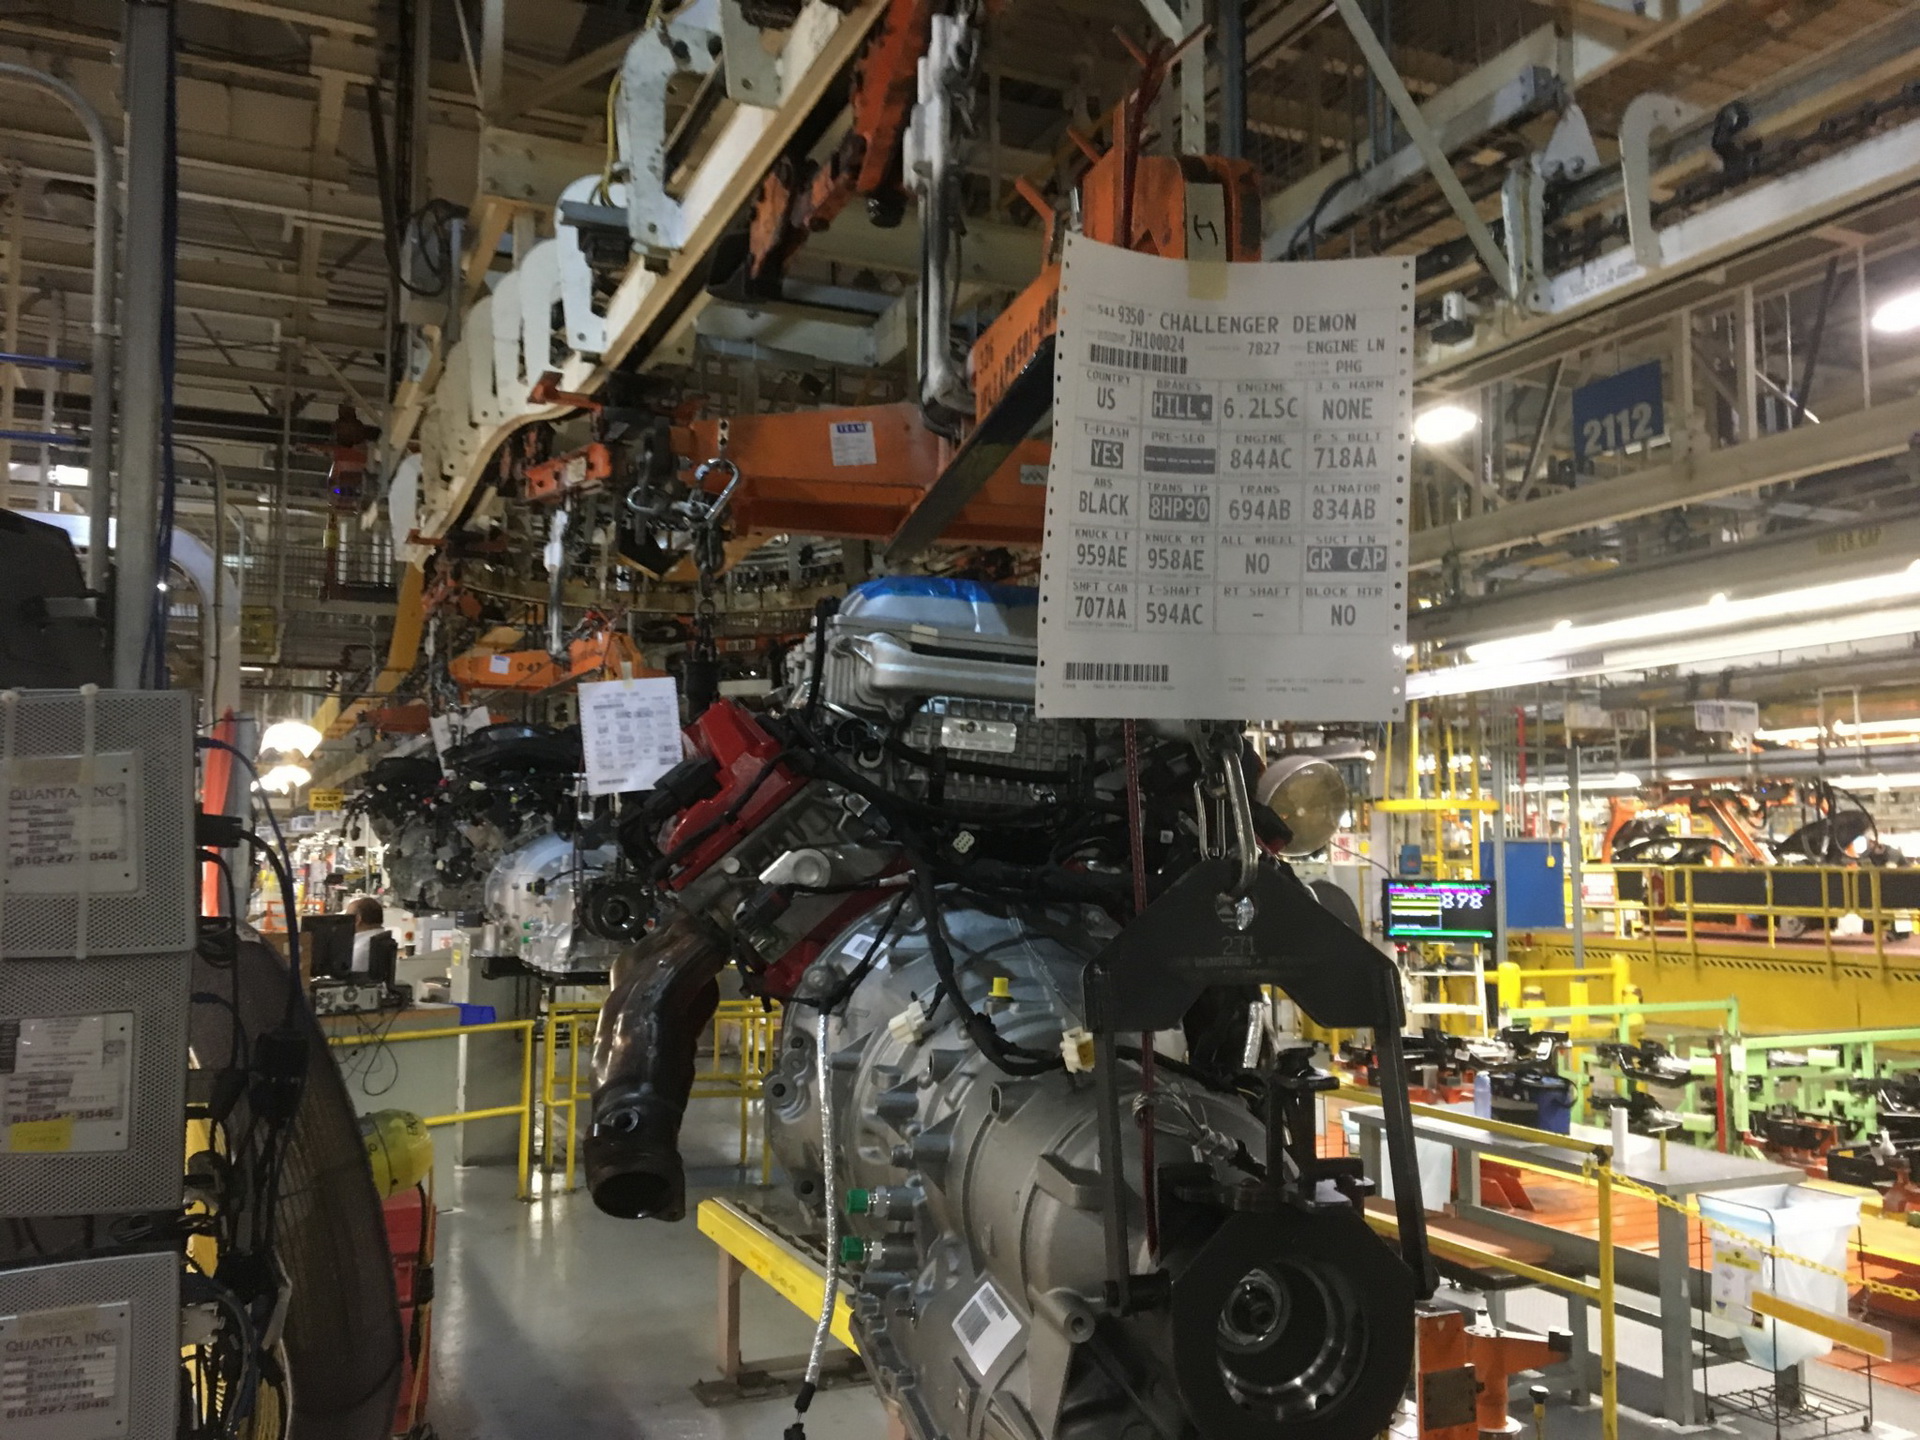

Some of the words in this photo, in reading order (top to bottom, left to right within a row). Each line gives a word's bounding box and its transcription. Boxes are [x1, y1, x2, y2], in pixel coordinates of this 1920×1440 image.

[1118, 305, 1145, 326] 9350
[1160, 311, 1279, 334] CHALLENGER
[1292, 313, 1357, 333] DEMON
[1306, 339, 1359, 354] ENGINE
[1367, 337, 1385, 351] LN
[1086, 369, 1130, 384] COUNTRY
[1336, 360, 1362, 373] PHG
[1156, 380, 1202, 392] BRAKES
[1236, 383, 1285, 393] ENGINE
[1097, 386, 1116, 410] US
[1223, 397, 1299, 419] 6.2LSC
[1322, 398, 1374, 420] NONE
[1235, 434, 1287, 445] ENGINE
[1583, 401, 1654, 458] 2112
[1093, 441, 1121, 466] YES
[1230, 448, 1292, 470] 844AC
[1314, 446, 1377, 469] 718AA
[1094, 477, 1113, 489] ABS
[1239, 485, 1280, 495] TRANS
[1312, 483, 1381, 495] ALTNATOR
[1079, 490, 1129, 516] BLACK
[1150, 495, 1209, 520] 8HP90
[1229, 499, 1291, 521] 694AB
[1312, 498, 1376, 520] 834AB
[1077, 543, 1128, 568] 959AE
[1147, 548, 1205, 571] 958AE
[1245, 552, 1270, 575] NO
[1308, 548, 1333, 570] GR
[1347, 547, 1385, 570] CAP
[1305, 586, 1347, 598] BLOCK
[1075, 595, 1128, 620] 707AA
[1146, 602, 1204, 626] 594AC
[1331, 604, 1356, 626] NO
[1441, 892, 1484, 909] 898
[1221, 935, 1256, 956] 271
